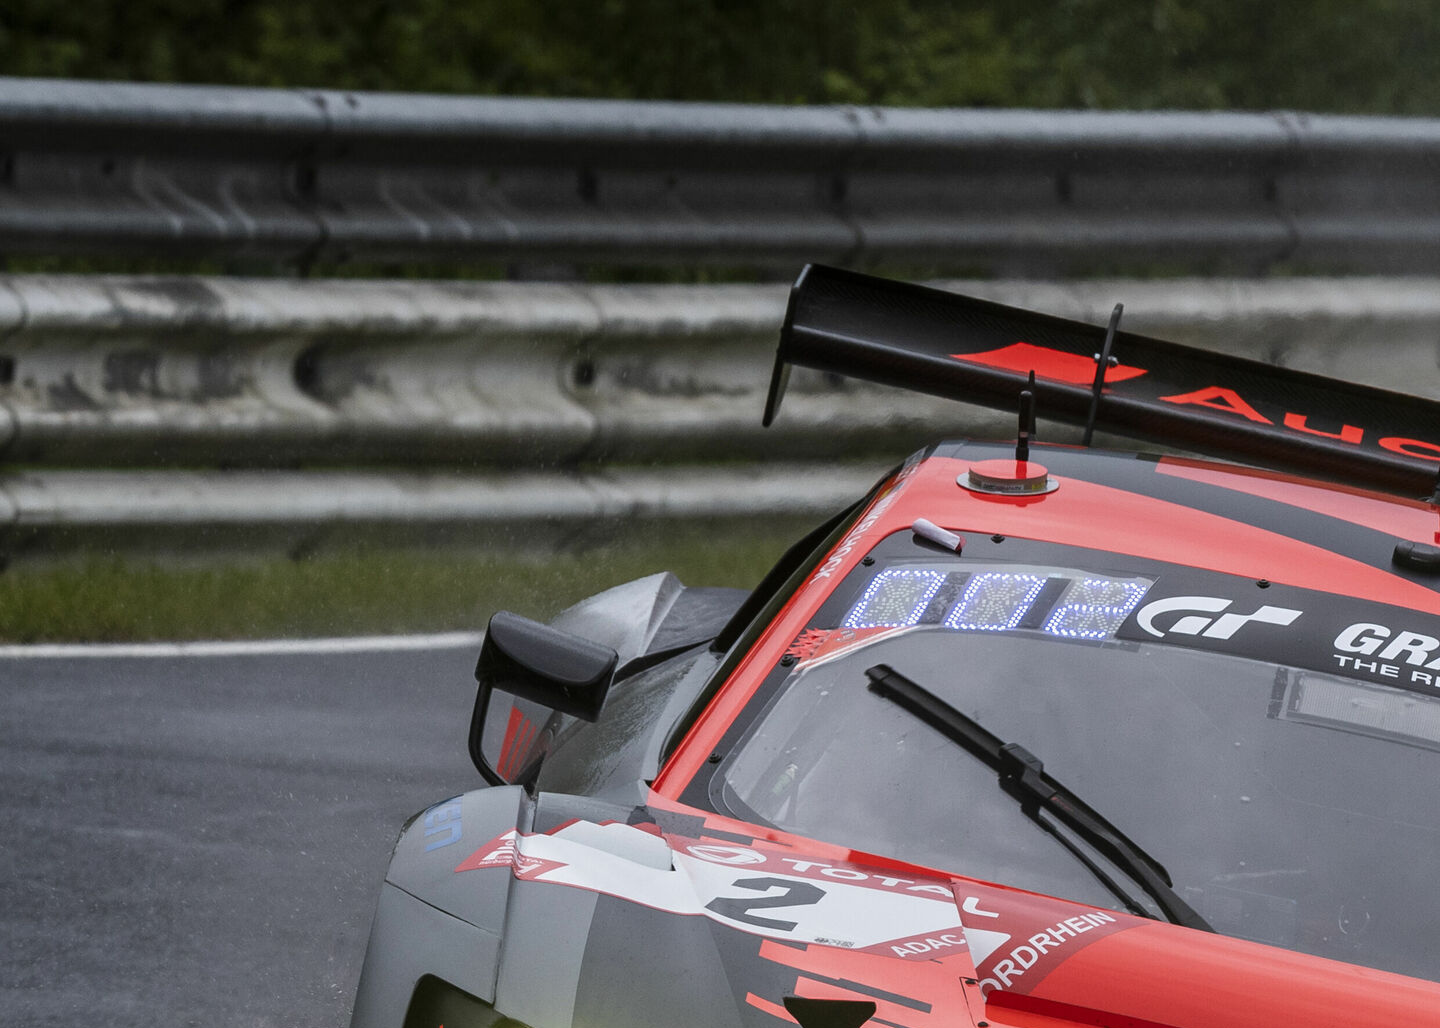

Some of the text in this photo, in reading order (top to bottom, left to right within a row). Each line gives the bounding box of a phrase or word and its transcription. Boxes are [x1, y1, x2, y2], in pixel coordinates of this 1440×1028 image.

[844, 568, 1149, 640] 002
[1333, 653, 1400, 679] THE
[704, 876, 828, 933] 2
[781, 857, 1000, 919] TOTAL
[890, 911, 1117, 1004] ADAC ORDRHEIN
